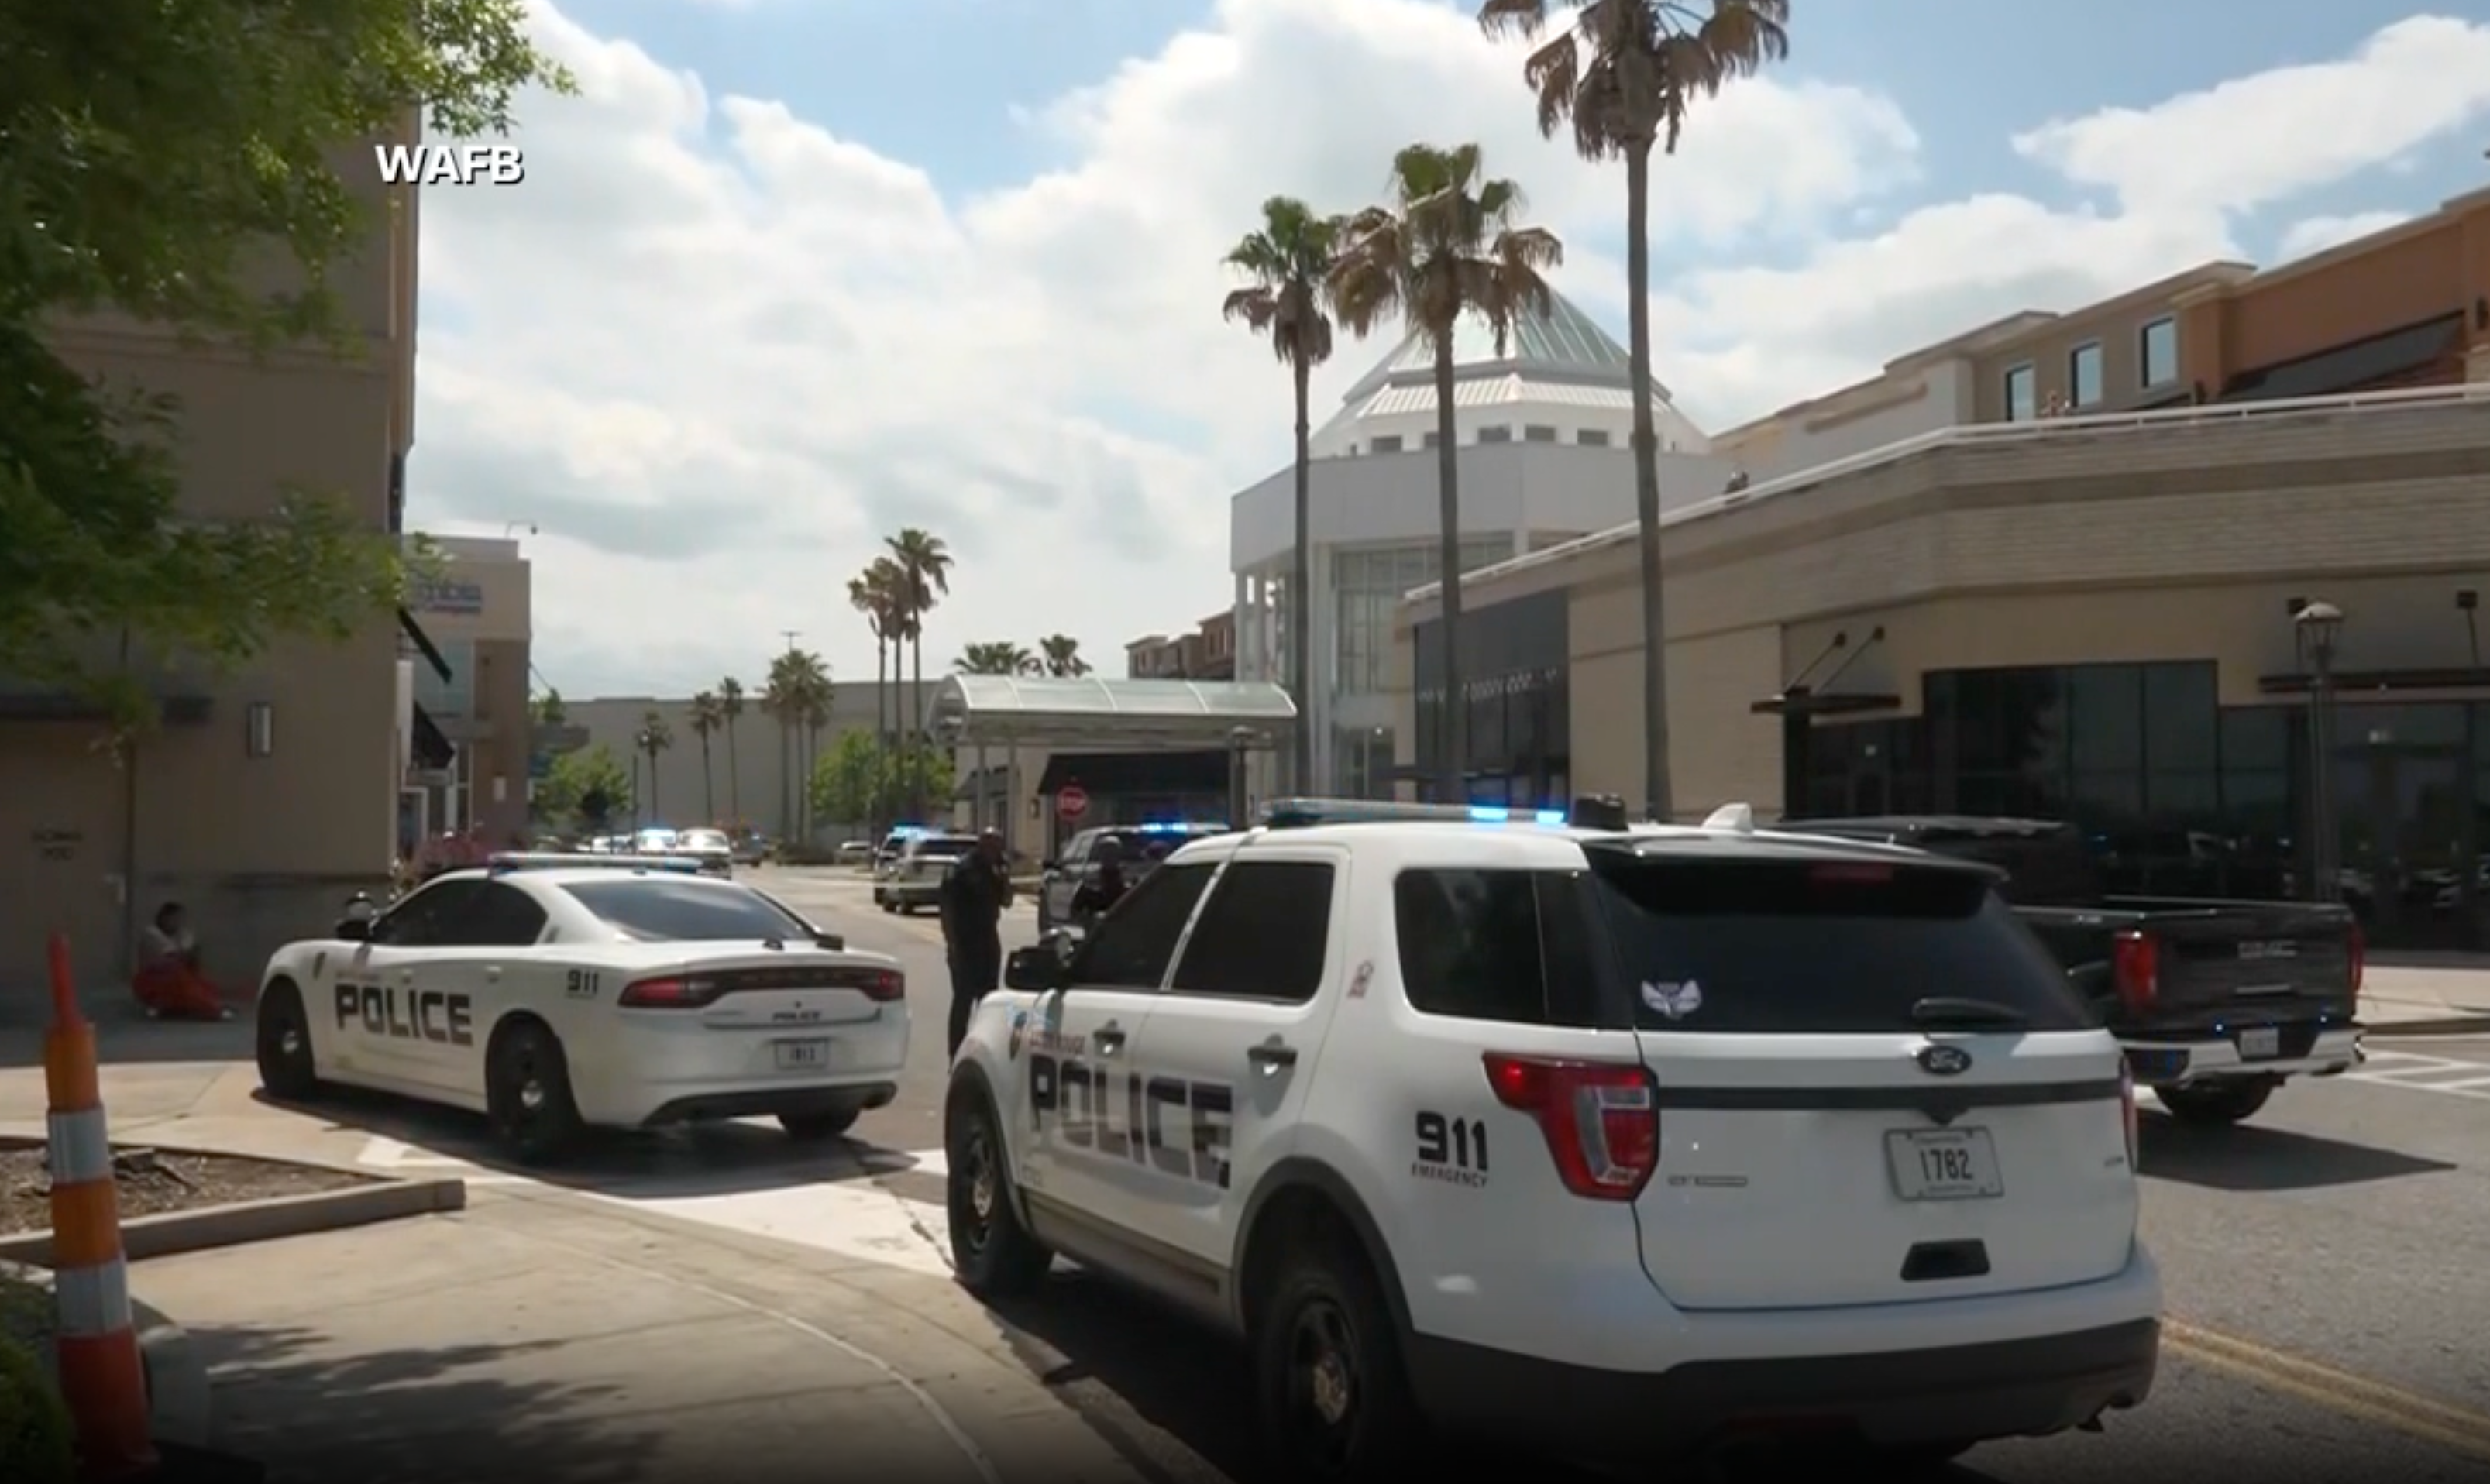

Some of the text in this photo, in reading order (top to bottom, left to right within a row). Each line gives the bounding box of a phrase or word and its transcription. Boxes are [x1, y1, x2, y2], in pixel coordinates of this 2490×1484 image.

[567, 968, 600, 994] 911
[334, 984, 474, 1047] POLICE
[1029, 1053, 1233, 1190] POLICE
[1415, 1110, 1489, 1172] 911
[1410, 1161, 1489, 1189] EMERGENCY
[1919, 1148, 1975, 1183] 1782
